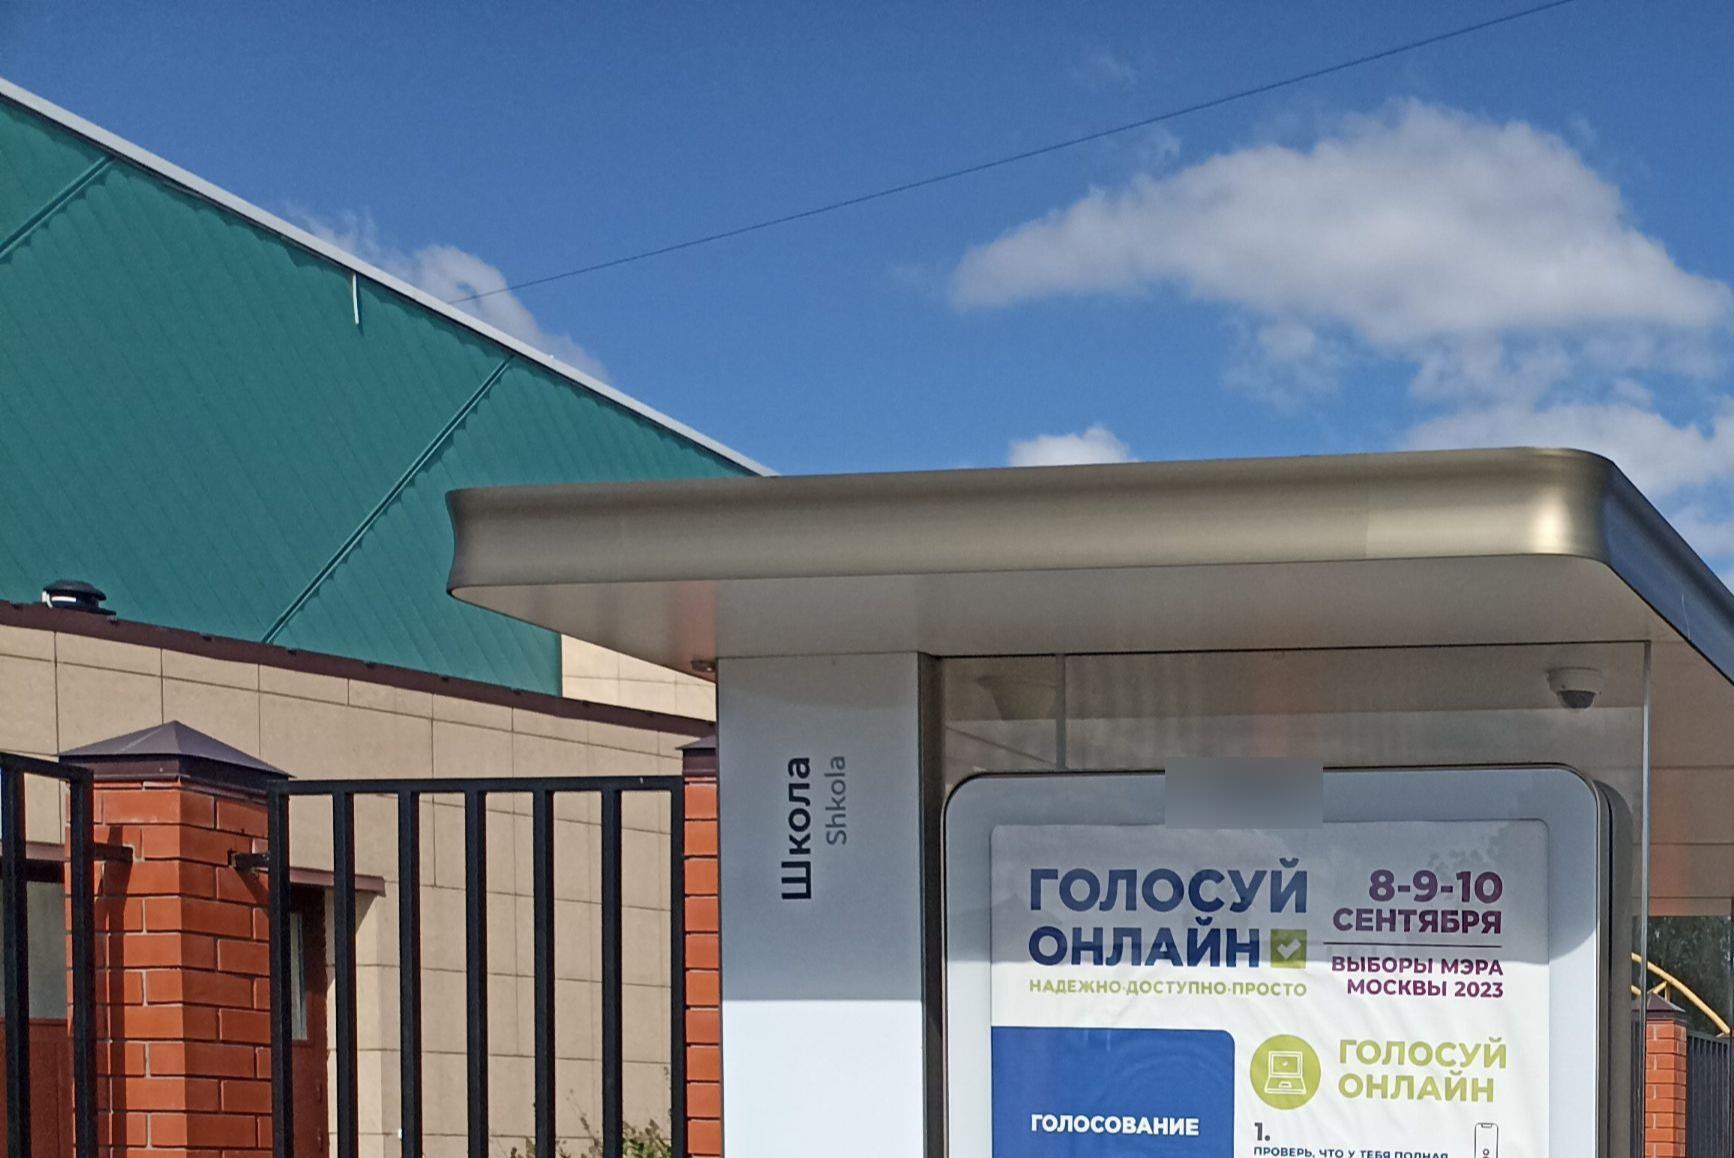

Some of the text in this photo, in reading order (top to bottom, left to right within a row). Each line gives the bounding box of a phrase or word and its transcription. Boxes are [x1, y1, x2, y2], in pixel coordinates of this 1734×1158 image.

[824, 755, 847, 845] Shkola
[781, 757, 812, 900] Школа
[1030, 857, 1307, 913] ГОЛОСУЙ
[1369, 869, 1503, 904] 8-9-10
[1333, 907, 1502, 934] СЕНТЯБРЯ
[1029, 916, 1260, 968] ОНЛАЙН
[1331, 956, 1504, 976] ВЫБОРЫ МЭРА
[1347, 979, 1504, 998] МОСКВЫ 2023
[1339, 1036, 1507, 1069] ГОЛОСУЙ
[1338, 1070, 1494, 1102] ОНЛАЙН
[1031, 1114, 1199, 1136] ГОЛОСОВАНИЕ
[1254, 1146, 1316, 1158] ПРОВЕРЬ,
[1318, 1148, 1344, 1158] ЧТО
